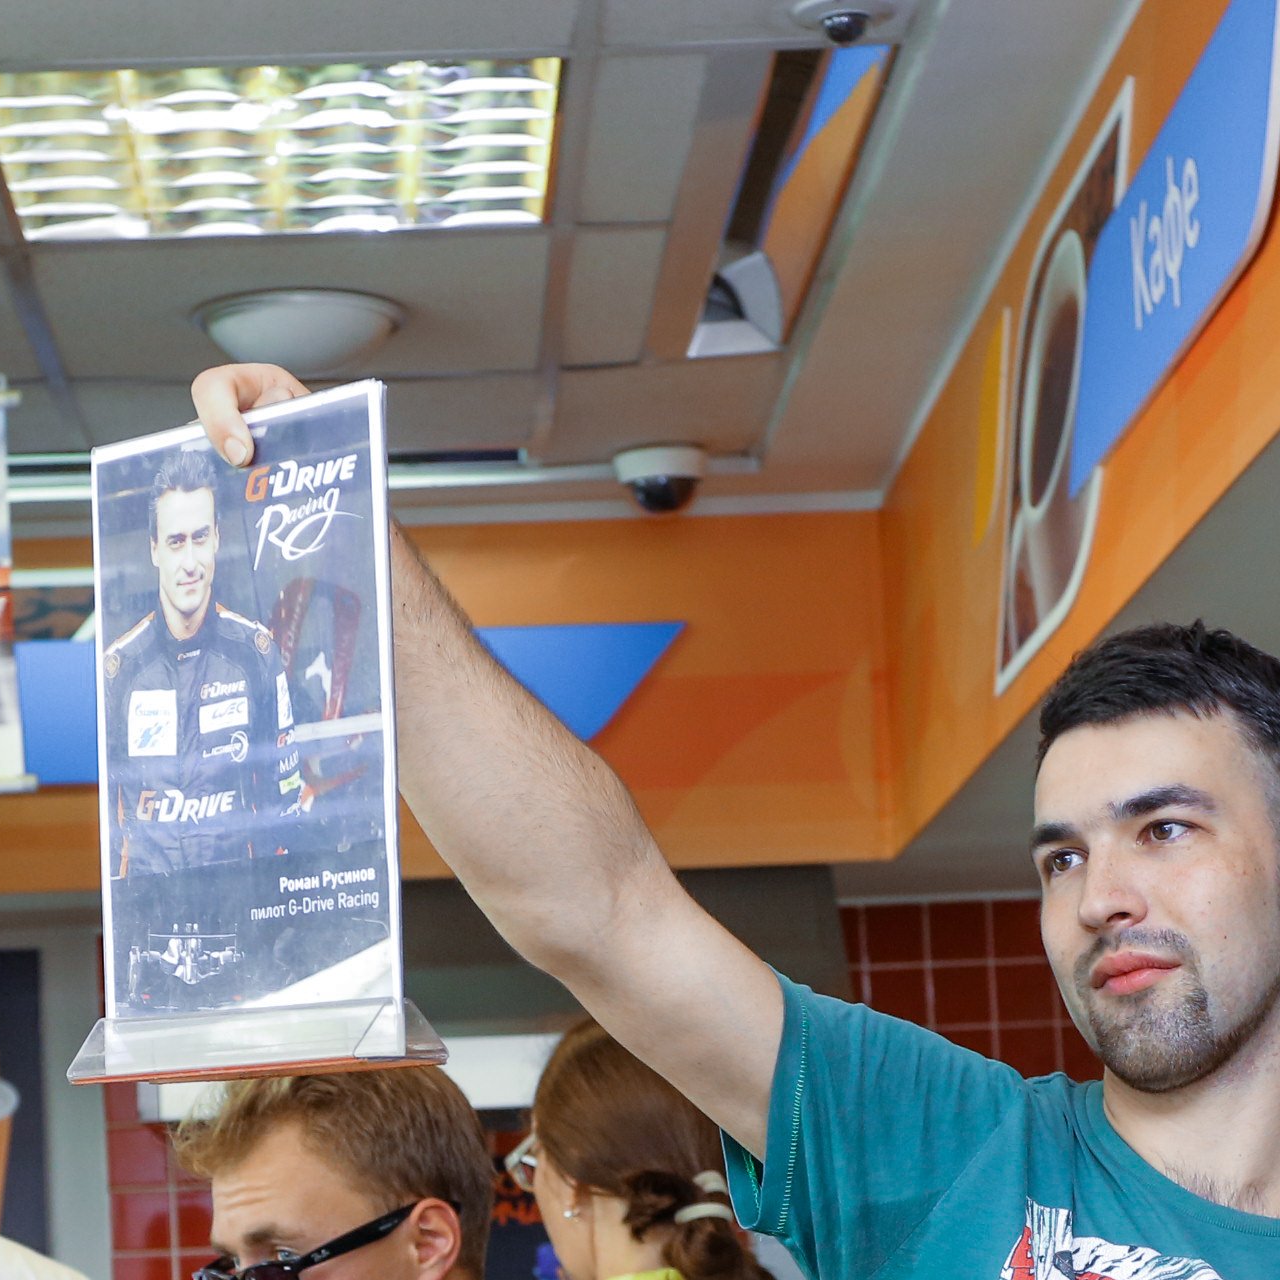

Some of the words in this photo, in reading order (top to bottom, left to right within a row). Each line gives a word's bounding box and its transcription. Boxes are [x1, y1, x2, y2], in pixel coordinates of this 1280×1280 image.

[1131, 156, 1200, 329] Кафе
[253, 487, 364, 571] Racing
[250, 903, 286, 921] пилот
[288, 897, 334, 916] G-Drive
[337, 890, 380, 911] Racing
[279, 875, 320, 894] Роман
[322, 867, 376, 890] Русинов
